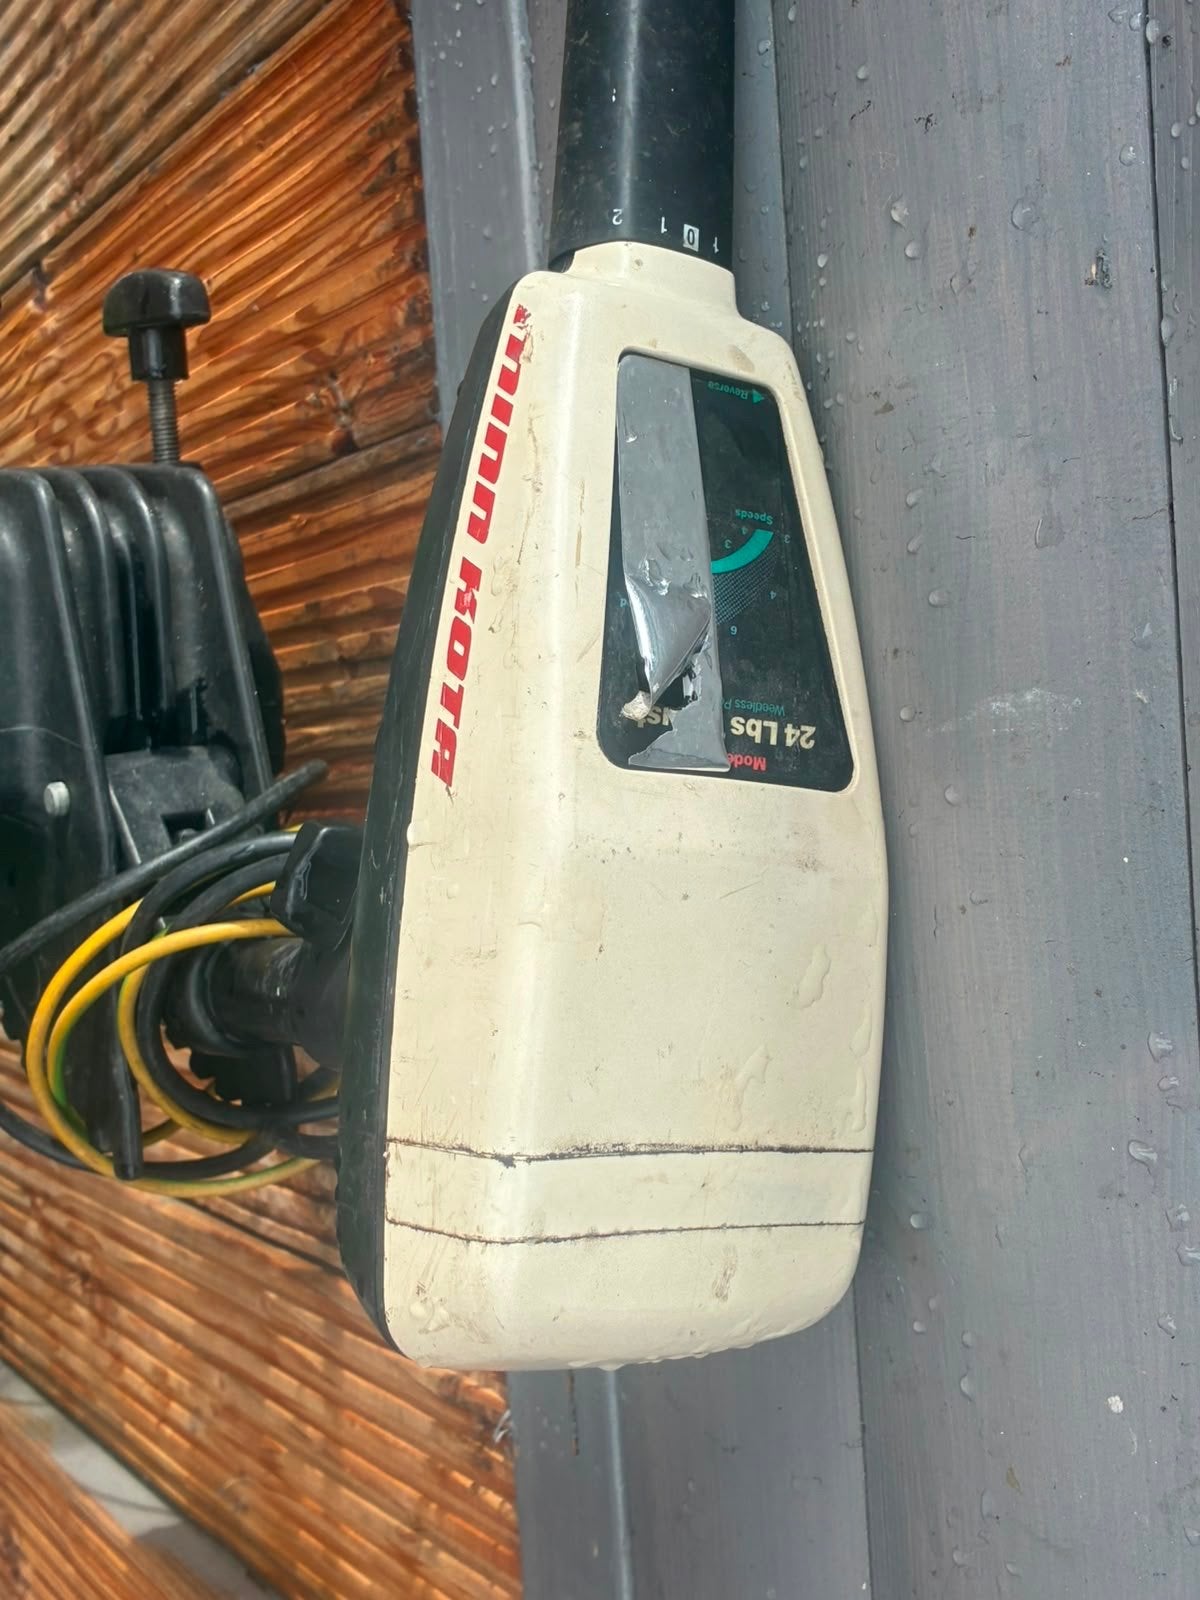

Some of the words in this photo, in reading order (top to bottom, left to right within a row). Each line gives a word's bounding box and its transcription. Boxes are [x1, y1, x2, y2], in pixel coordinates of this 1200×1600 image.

[611, 208, 623, 225] 2
[660, 216, 668, 234] 1
[707, 381, 749, 400] Reverse
[735, 508, 774, 526] Speeds
[724, 539, 732, 549] 3
[783, 534, 791, 544] 3
[769, 590, 777, 600] 4
[730, 625, 738, 635] 6
[431, 557, 483, 787] KOTA
[734, 699, 785, 717] Weedless
[730, 716, 778, 746] Lbs
[784, 722, 816, 749] 24
[726, 752, 767, 772] Mode
